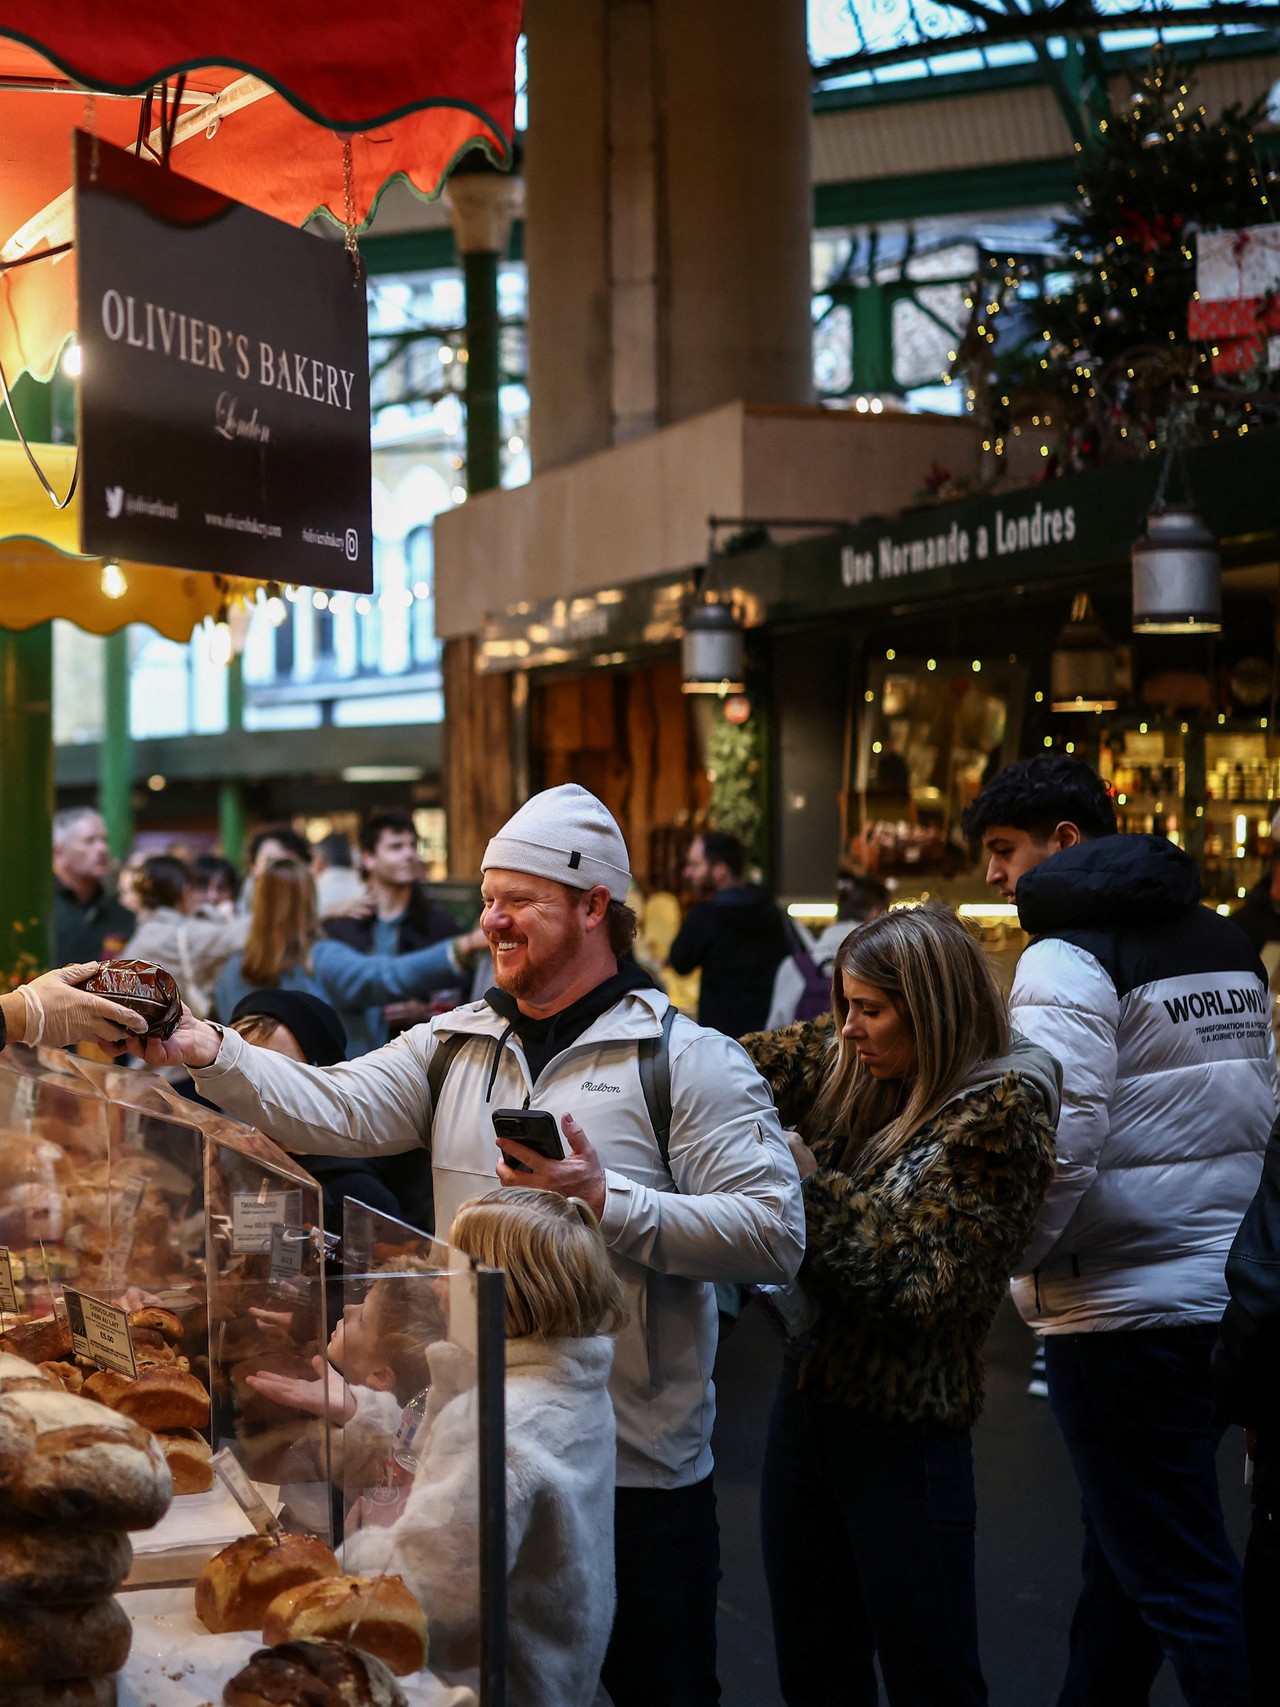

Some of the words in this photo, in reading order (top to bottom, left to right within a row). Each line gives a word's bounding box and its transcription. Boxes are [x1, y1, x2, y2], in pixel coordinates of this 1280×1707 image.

[102, 289, 250, 380] OLIVIER'S
[259, 341, 355, 410] BAKERY
[841, 546, 874, 587] Une
[878, 520, 969, 579] Normande
[976, 525, 988, 559] a
[995, 501, 1076, 554] Londres
[1163, 989, 1266, 1024] WORLDWI
[1212, 1032, 1235, 1041] JOURNEY
[1236, 1031, 1245, 1039] OF
[581, 1081, 621, 1093] Malbon
